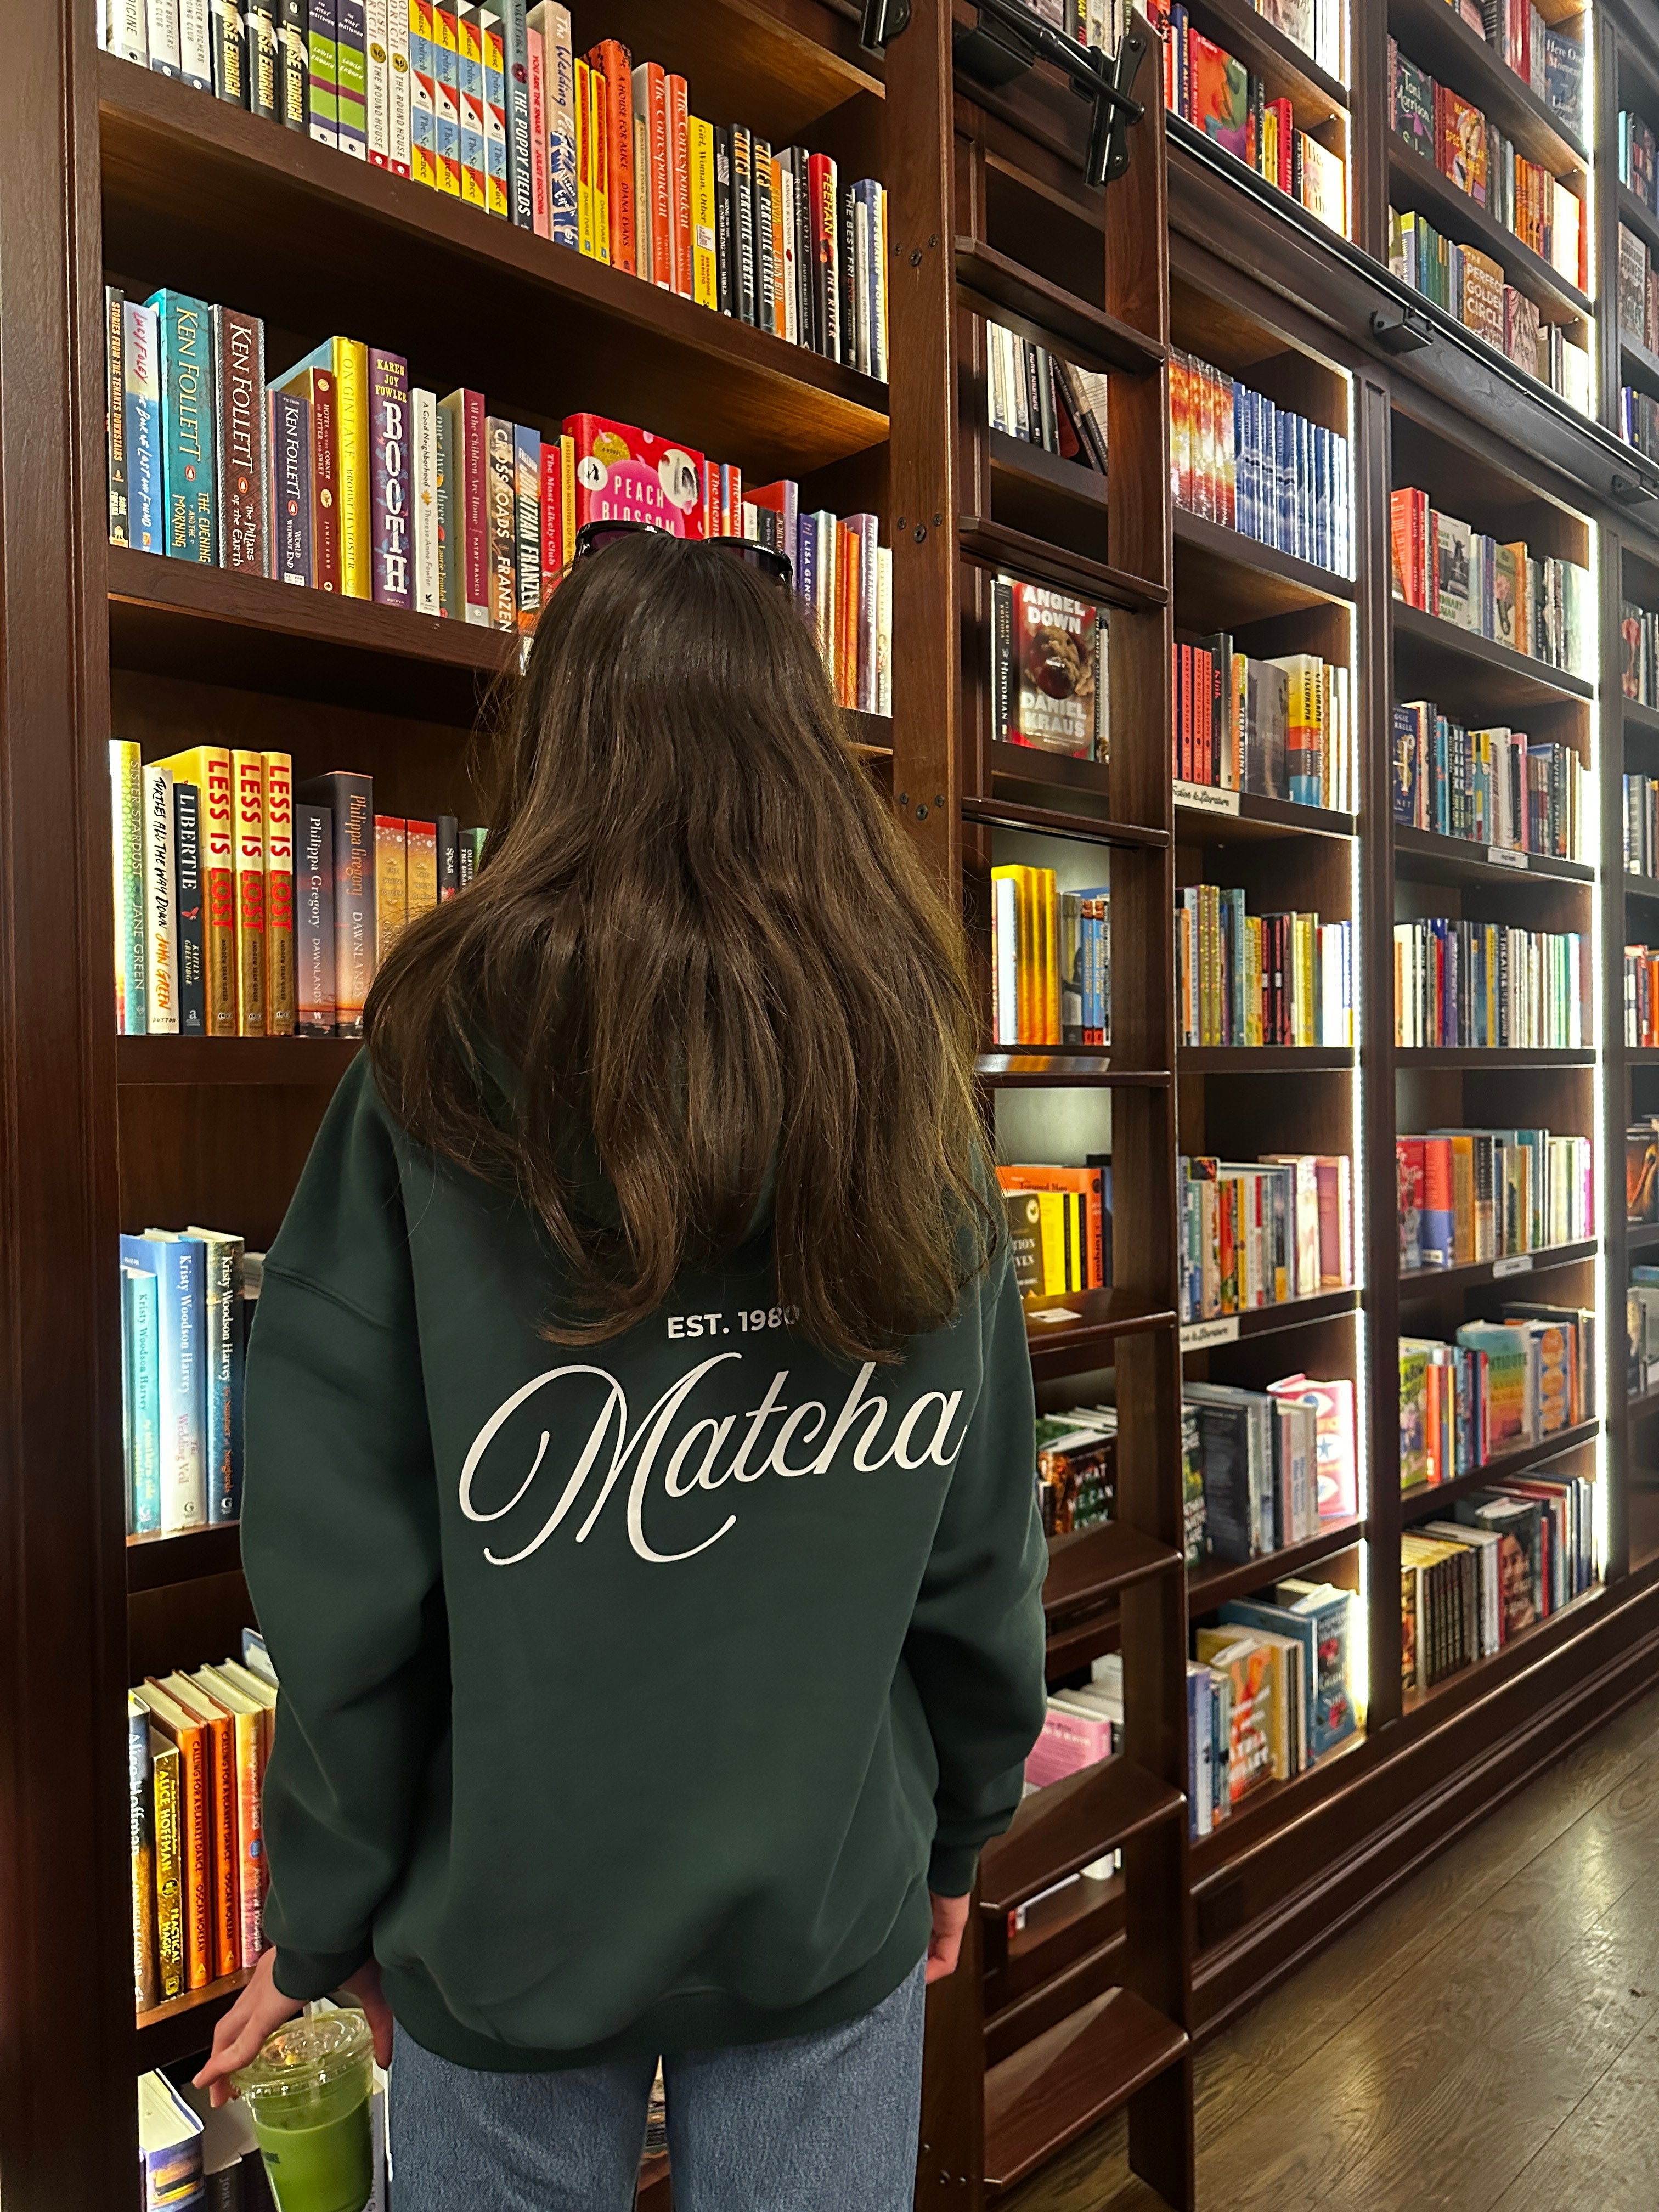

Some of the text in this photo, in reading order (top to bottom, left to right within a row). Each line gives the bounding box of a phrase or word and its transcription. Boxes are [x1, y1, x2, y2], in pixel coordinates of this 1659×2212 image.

[224, 41, 240, 98] ERDRICH
[259, 54, 273, 110] ERDRICH
[552, 16, 572, 106] The Wedding
[287, 68, 302, 122] ERDRICH
[374, 65, 383, 149] THE ROUND HOUSE
[514, 91, 531, 217] THE POPPY FIELDS
[619, 120, 628, 140] FOR
[698, 124, 708, 223] Girl, Woman, Other
[733, 132, 754, 298] JAMES PERCIVAL EVERETT
[755, 144, 775, 308] JAMES PERCIVAL EVERETT
[823, 172, 834, 235] FEEHAN
[845, 193, 854, 215] THE
[845, 221, 854, 252] BEST
[1466, 264, 1504, 292] PERFECT
[1466, 281, 1503, 311] GOLDEN
[828, 296, 836, 338] RIVER
[1466, 298, 1504, 330] CIRCLE
[112, 302, 122, 461] STORIES FROM THE TENANTS DOWNSTAIRS
[176, 307, 201, 462] KEN FOLLETT
[375, 385, 407, 403] FOWLER
[377, 359, 405, 376] KAREN
[384, 374, 400, 388] JOY
[230, 323, 253, 475] KEN FOLLETT
[285, 406, 299, 434] KEN
[343, 386, 355, 459] GIN LANE
[285, 436, 300, 499] FOLLETT
[420, 433, 431, 487] Neighborhood
[470, 401, 480, 524] All the Children Are Home
[383, 401, 408, 595] BOOTH
[614, 475, 664, 509] PEACH
[172, 494, 186, 548] MORNING
[198, 492, 212, 563] THE EVENING
[520, 463, 540, 611] JONATHAN FRANZEN
[497, 555, 512, 633] FRANZEN
[1023, 585, 1086, 617] ANGEL
[1028, 606, 1081, 635] DOWN
[1001, 661, 1009, 720] HISTORIAN
[1020, 692, 1087, 720] DANIEL
[1024, 712, 1085, 738] KRAUS
[153, 777, 167, 818] TURTLES
[180, 793, 198, 890] LIBERTIE
[208, 760, 233, 932] LESS IS LOST
[240, 764, 264, 933] LESS IS LOST
[130, 761, 144, 990] SISTER STARDUST JANE GREEN
[154, 866, 168, 895] WAY
[345, 795, 367, 999] Philippa Gregory DAWNLANDS
[156, 893, 169, 934] DOWN
[307, 817, 322, 1004] Philippa Gregory DAWNLANDS
[155, 933, 172, 968] JOHN
[156, 968, 172, 1011] GREEN
[177, 1255, 193, 1395] Kristy Woodson Harvey
[217, 1256, 234, 1381] Kristy Woodson Harvey
[668, 1313, 730, 1339] EST.
[458, 1351, 968, 1566] Matcha
[158, 1770, 172, 1872] ALICE HOFFMAN
[162, 1922, 171, 1957] MAGIC
[171, 1908, 180, 1963] PRACTICAL
